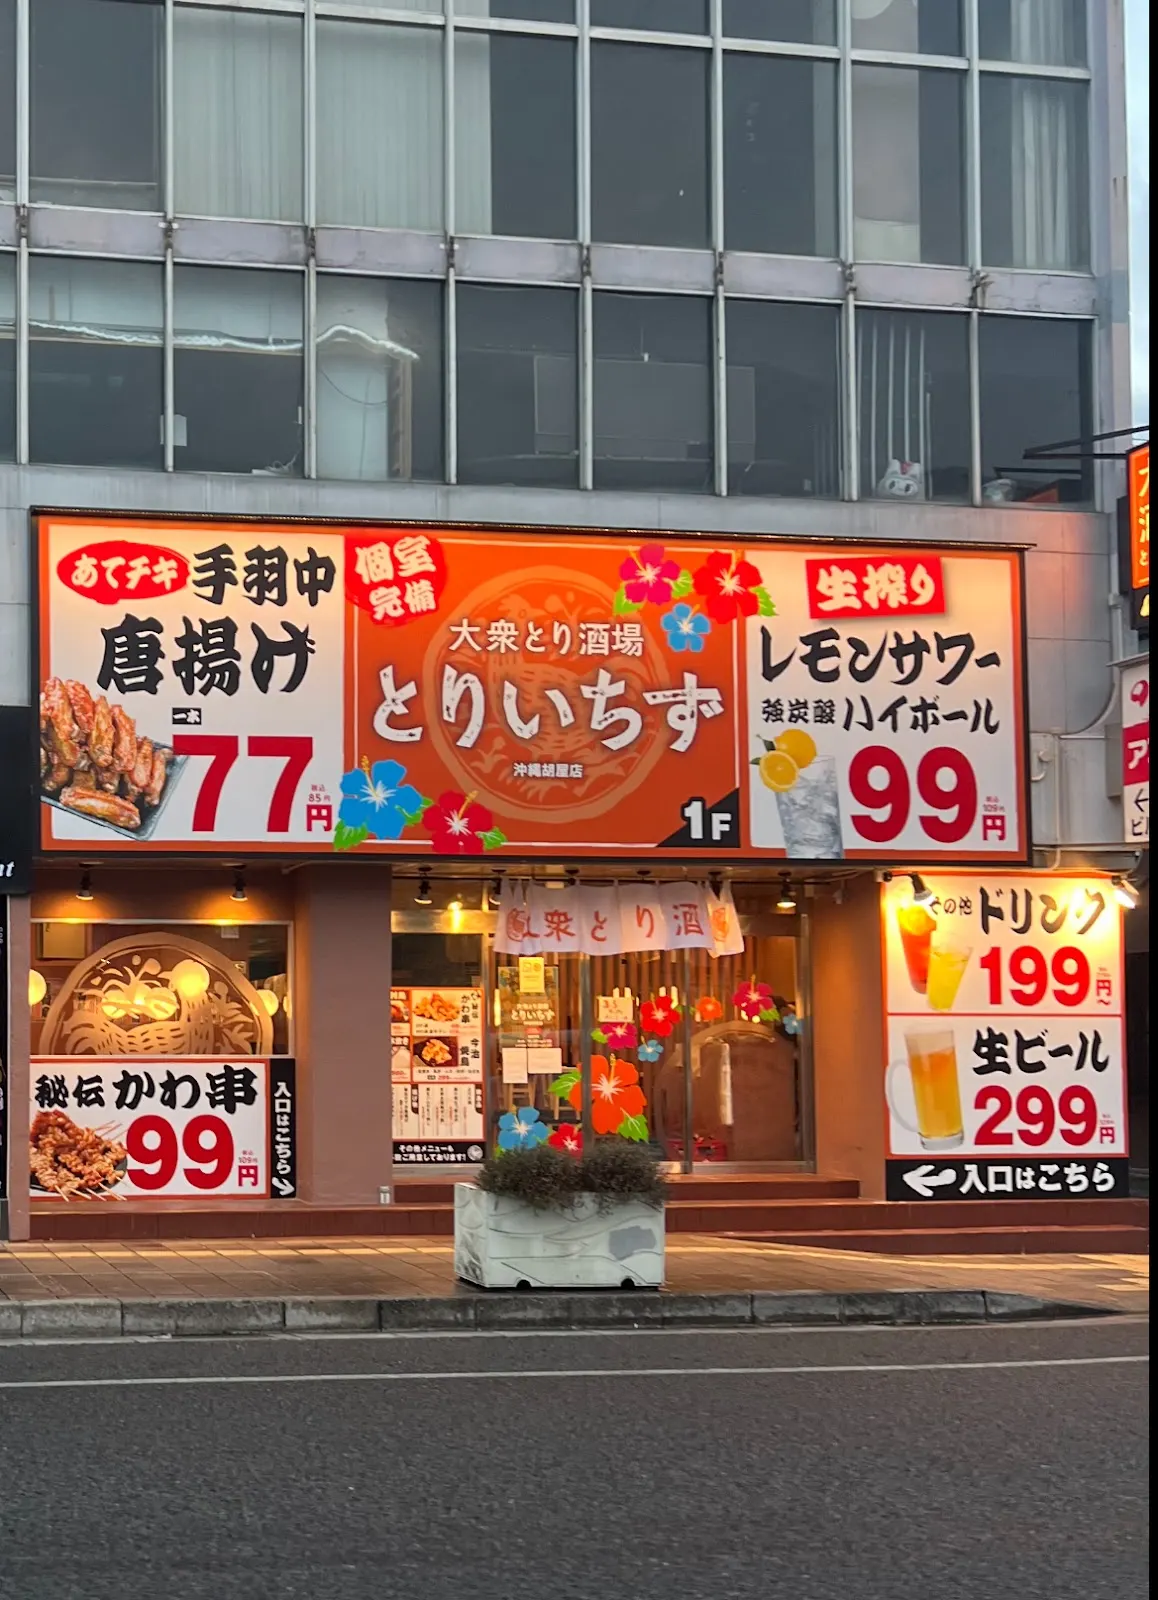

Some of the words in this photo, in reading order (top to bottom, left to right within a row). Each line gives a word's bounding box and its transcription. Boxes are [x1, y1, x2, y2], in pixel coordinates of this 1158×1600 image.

[71, 554, 179, 590] あてチキ
[192, 543, 337, 607] 手羽中
[355, 535, 436, 584] 個室
[369, 579, 436, 620] 完備
[816, 563, 936, 612] 生搾り
[97, 613, 316, 695] 唐揚げ
[449, 619, 645, 657] 大衆とり酒場
[760, 625, 1001, 685] レモンサワー
[373, 664, 724, 752] とりいちず
[1127, 738, 1149, 770] ア
[681, 797, 732, 841] 1F
[972, 1026, 1110, 1075] 生ビール
[274, 1082, 292, 1174] 入口はこちら
[959, 1162, 1116, 1194] 入口はこちら
